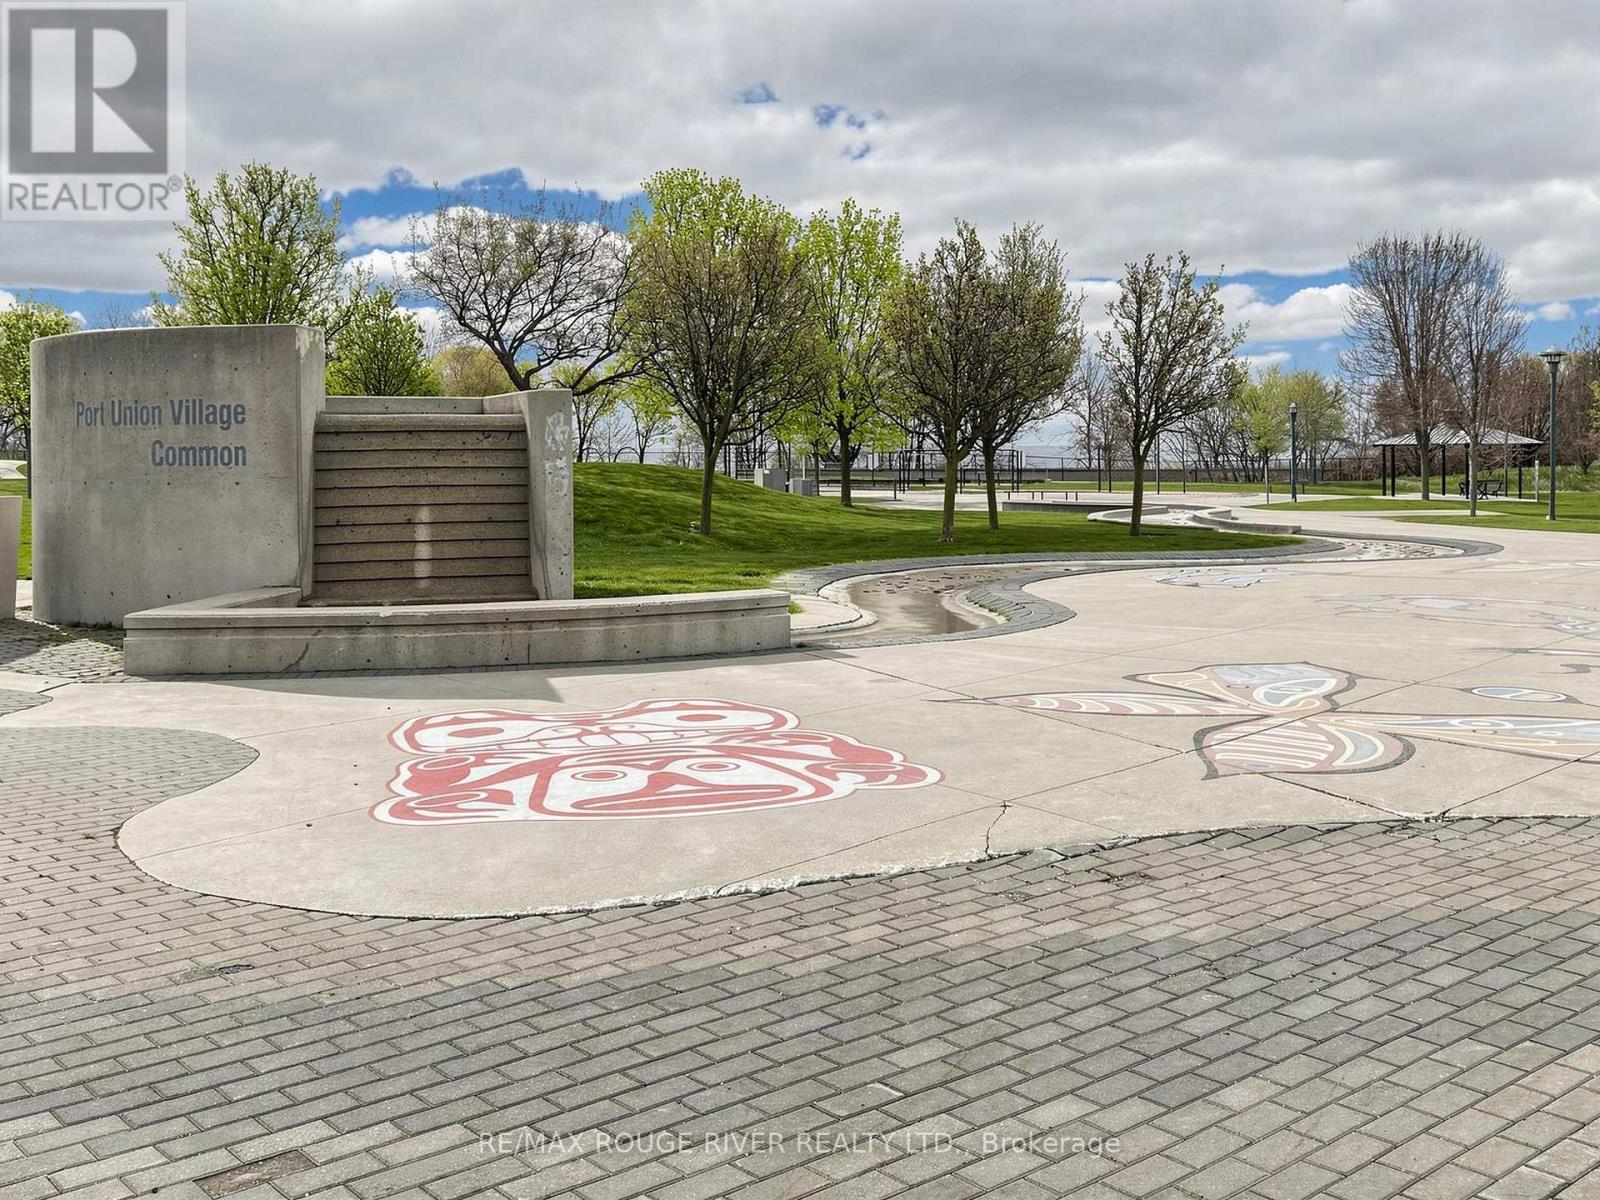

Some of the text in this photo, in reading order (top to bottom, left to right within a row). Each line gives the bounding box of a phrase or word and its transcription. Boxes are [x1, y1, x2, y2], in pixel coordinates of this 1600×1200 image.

[76, 399, 247, 431] Port Union Village
[152, 439, 248, 467] Common
